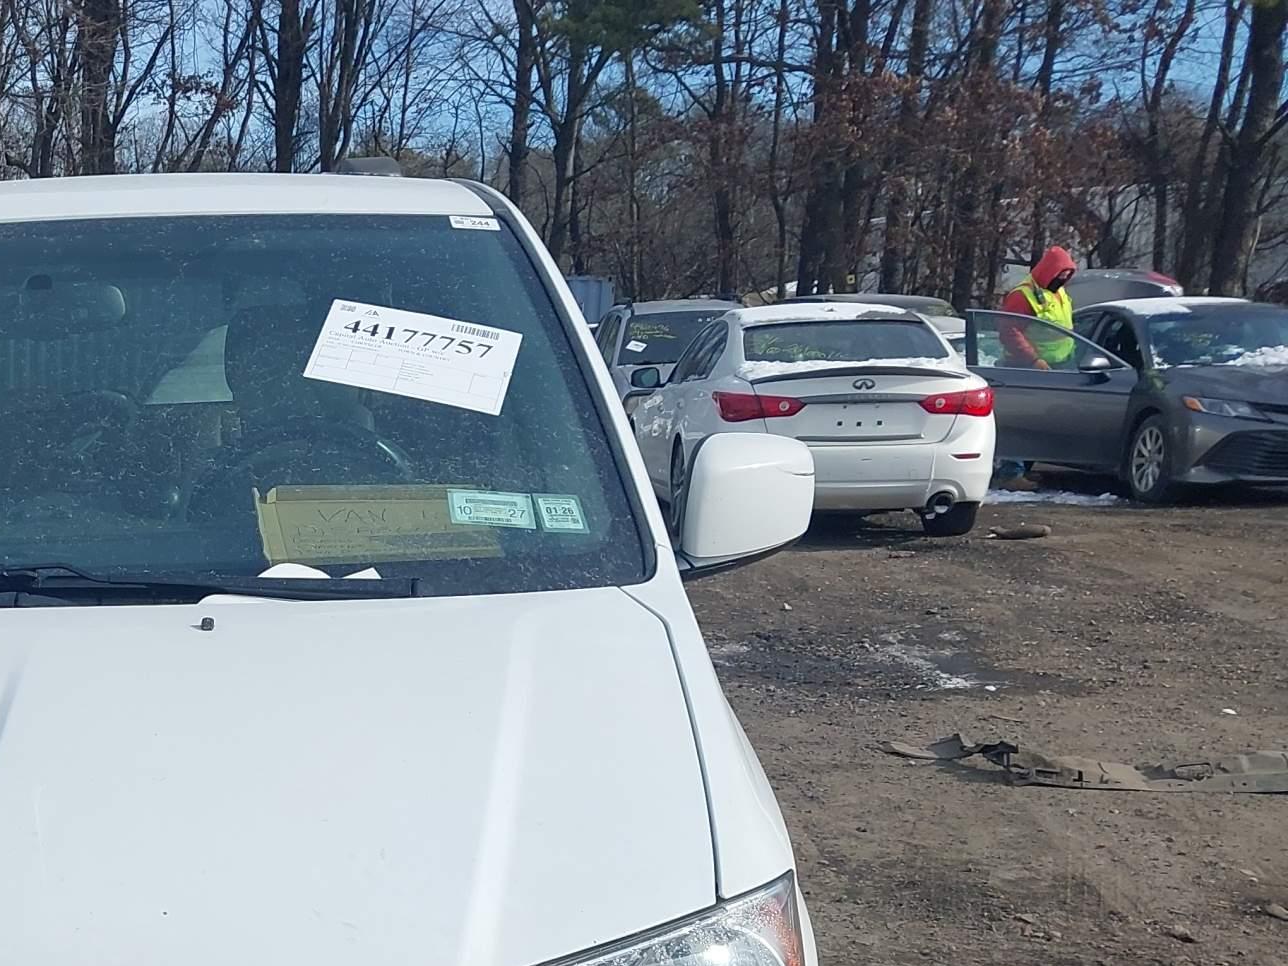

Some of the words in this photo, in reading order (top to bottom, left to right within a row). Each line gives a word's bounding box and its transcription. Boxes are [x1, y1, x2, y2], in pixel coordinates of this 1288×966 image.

[343, 318, 494, 359] 44177757
[456, 504, 472, 516] 10
[507, 508, 526, 519] 27
